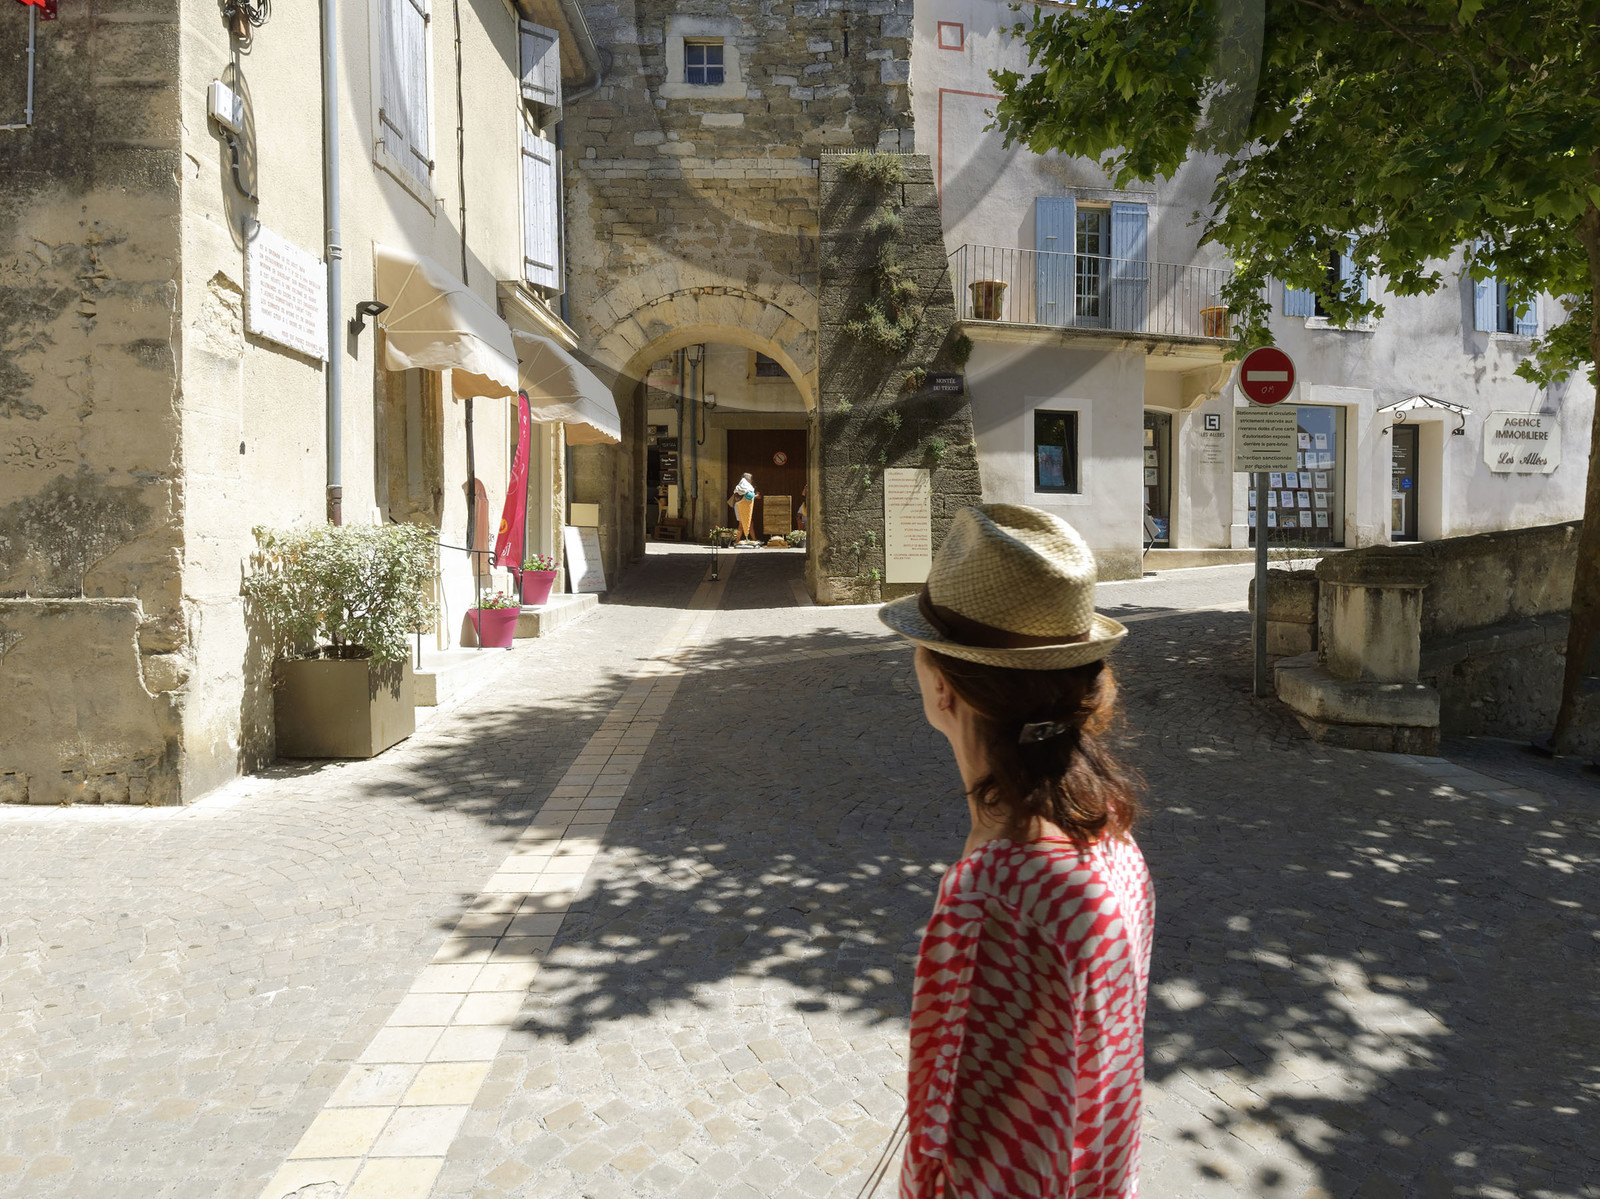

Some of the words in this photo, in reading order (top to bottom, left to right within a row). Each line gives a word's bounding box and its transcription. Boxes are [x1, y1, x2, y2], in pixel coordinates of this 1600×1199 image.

[1504, 417, 1541, 428] AGENCE
[1495, 429, 1549, 441] IMMOBILIERE
[1498, 451, 1514, 464] Les
